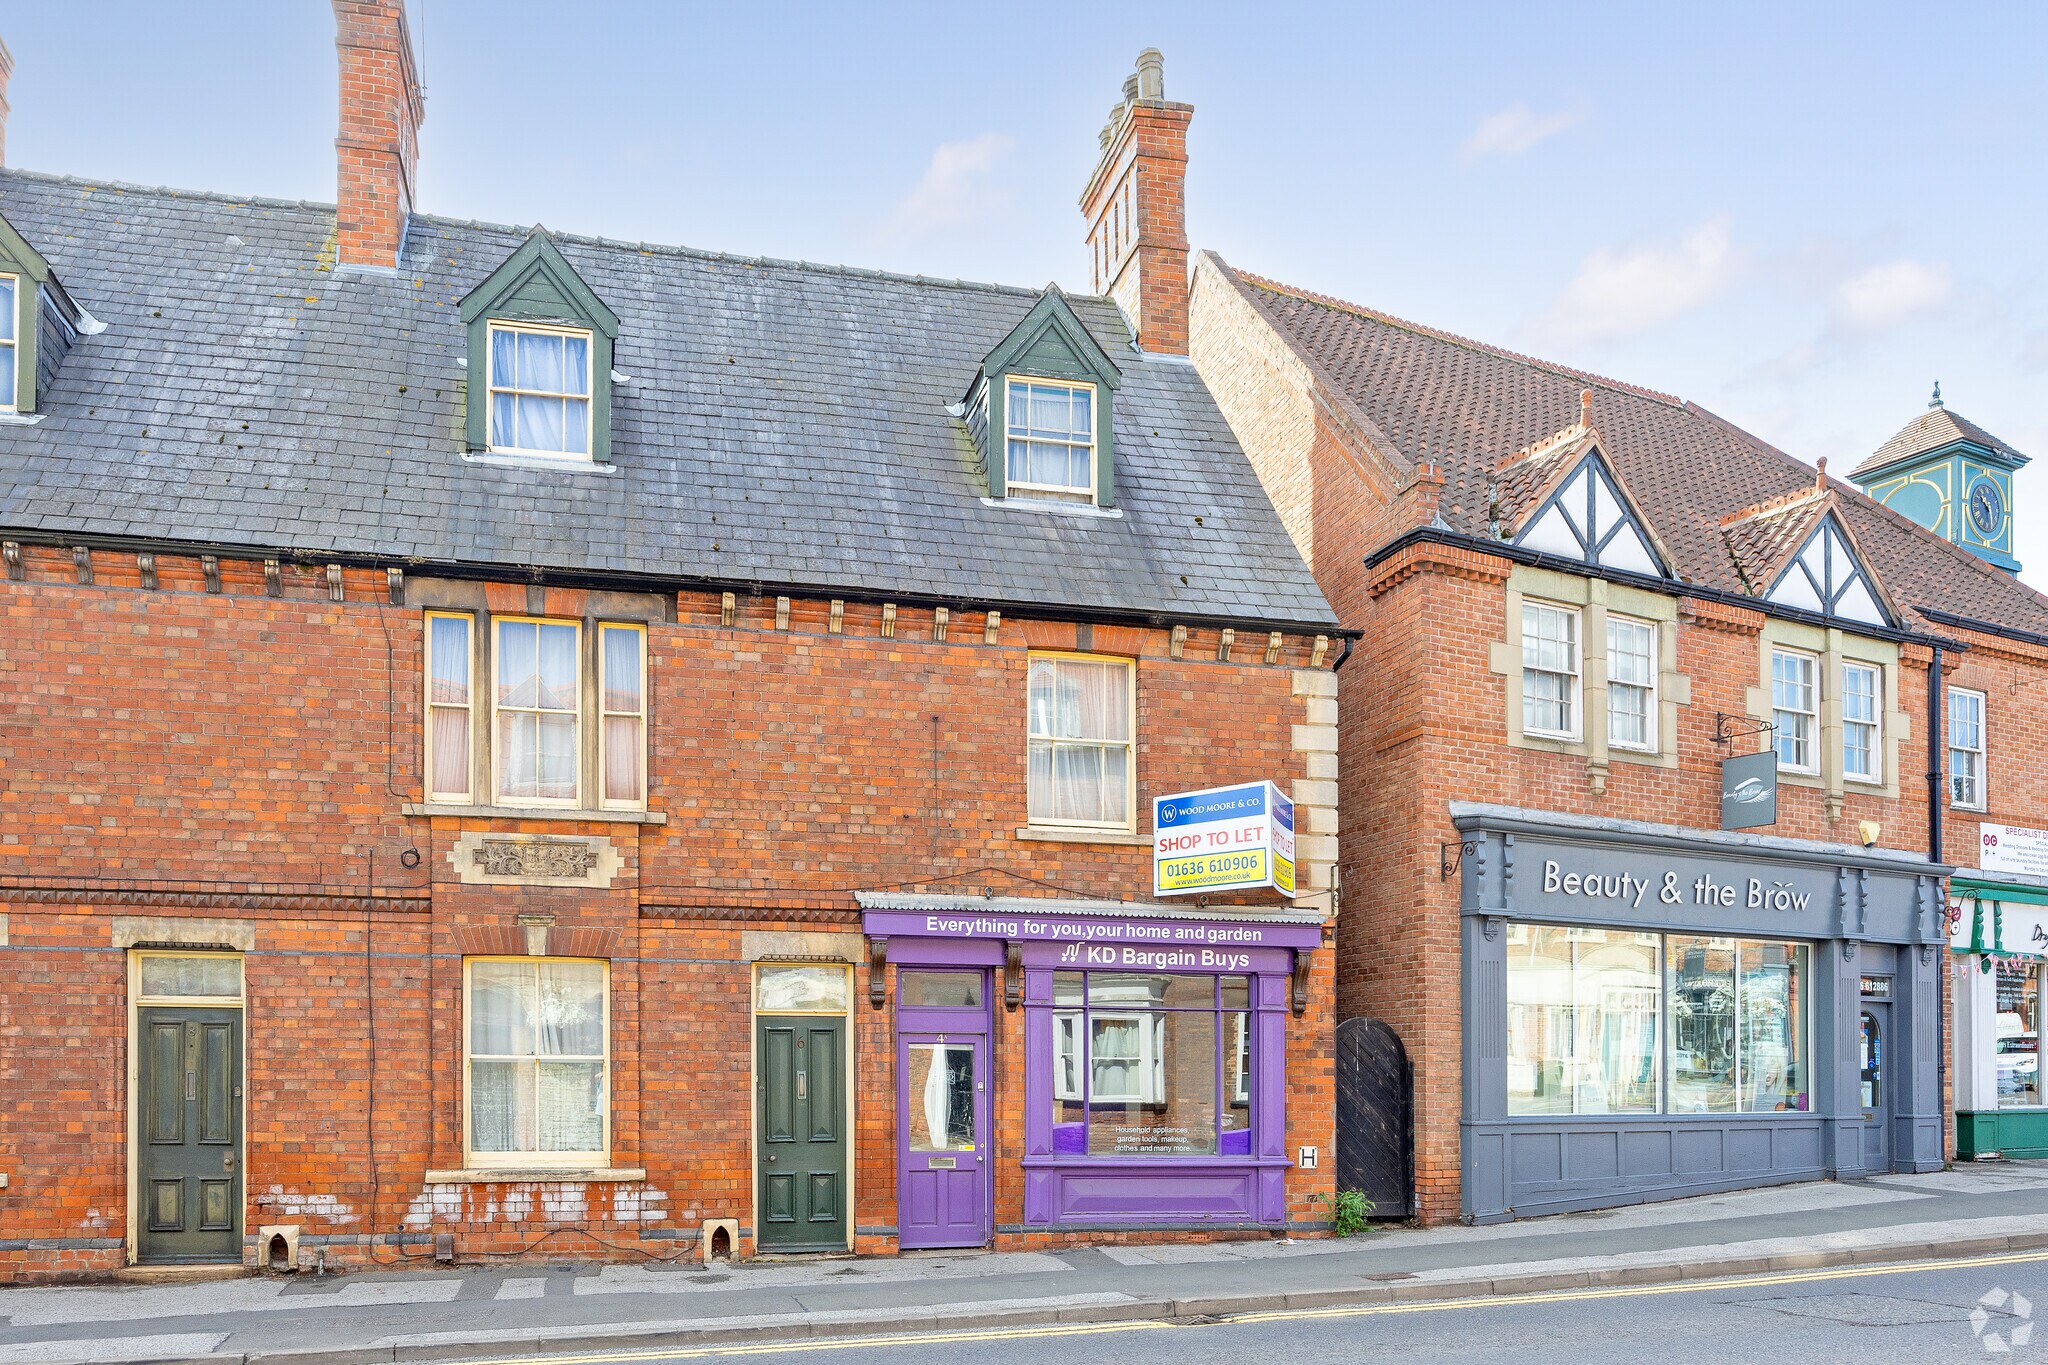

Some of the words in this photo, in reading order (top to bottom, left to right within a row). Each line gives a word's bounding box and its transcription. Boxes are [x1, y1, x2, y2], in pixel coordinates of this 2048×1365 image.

[1179, 806, 1205, 816] WOOD
[1206, 801, 1236, 813] MOORE
[1237, 799, 1245, 808] &
[1246, 798, 1261, 806] CO.
[1159, 834, 1202, 853] SHOP
[1206, 831, 1229, 847] TO
[1235, 826, 1264, 843] LET
[2005, 827, 2041, 839] SPECIALIST
[1167, 861, 1204, 878] 01636
[1208, 855, 1258, 873] 610906
[1175, 871, 1251, 887] www.woodmoore.co.uk
[1543, 859, 1650, 908] Beauty
[1659, 871, 1683, 904] &
[1694, 874, 1736, 907] the
[926, 916, 1018, 936] Everything
[1023, 919, 1047, 935] for
[1126, 923, 1170, 939] home
[1175, 926, 1205, 940] and
[1207, 927, 1262, 943] garden
[1087, 947, 1116, 964] KD
[1122, 948, 1196, 969] Bargain
[1201, 950, 1250, 970] Buys
[796, 1035, 805, 1049] 6
[1115, 1126, 1150, 1134] Household
[1152, 1126, 1190, 1135] appliances,
[1116, 1135, 1140, 1144] garden
[1141, 1136, 1160, 1144] tools,
[1160, 1136, 1189, 1144] makeup,
[1153, 1145, 1172, 1153] many
[1301, 1148, 1315, 1167] H
